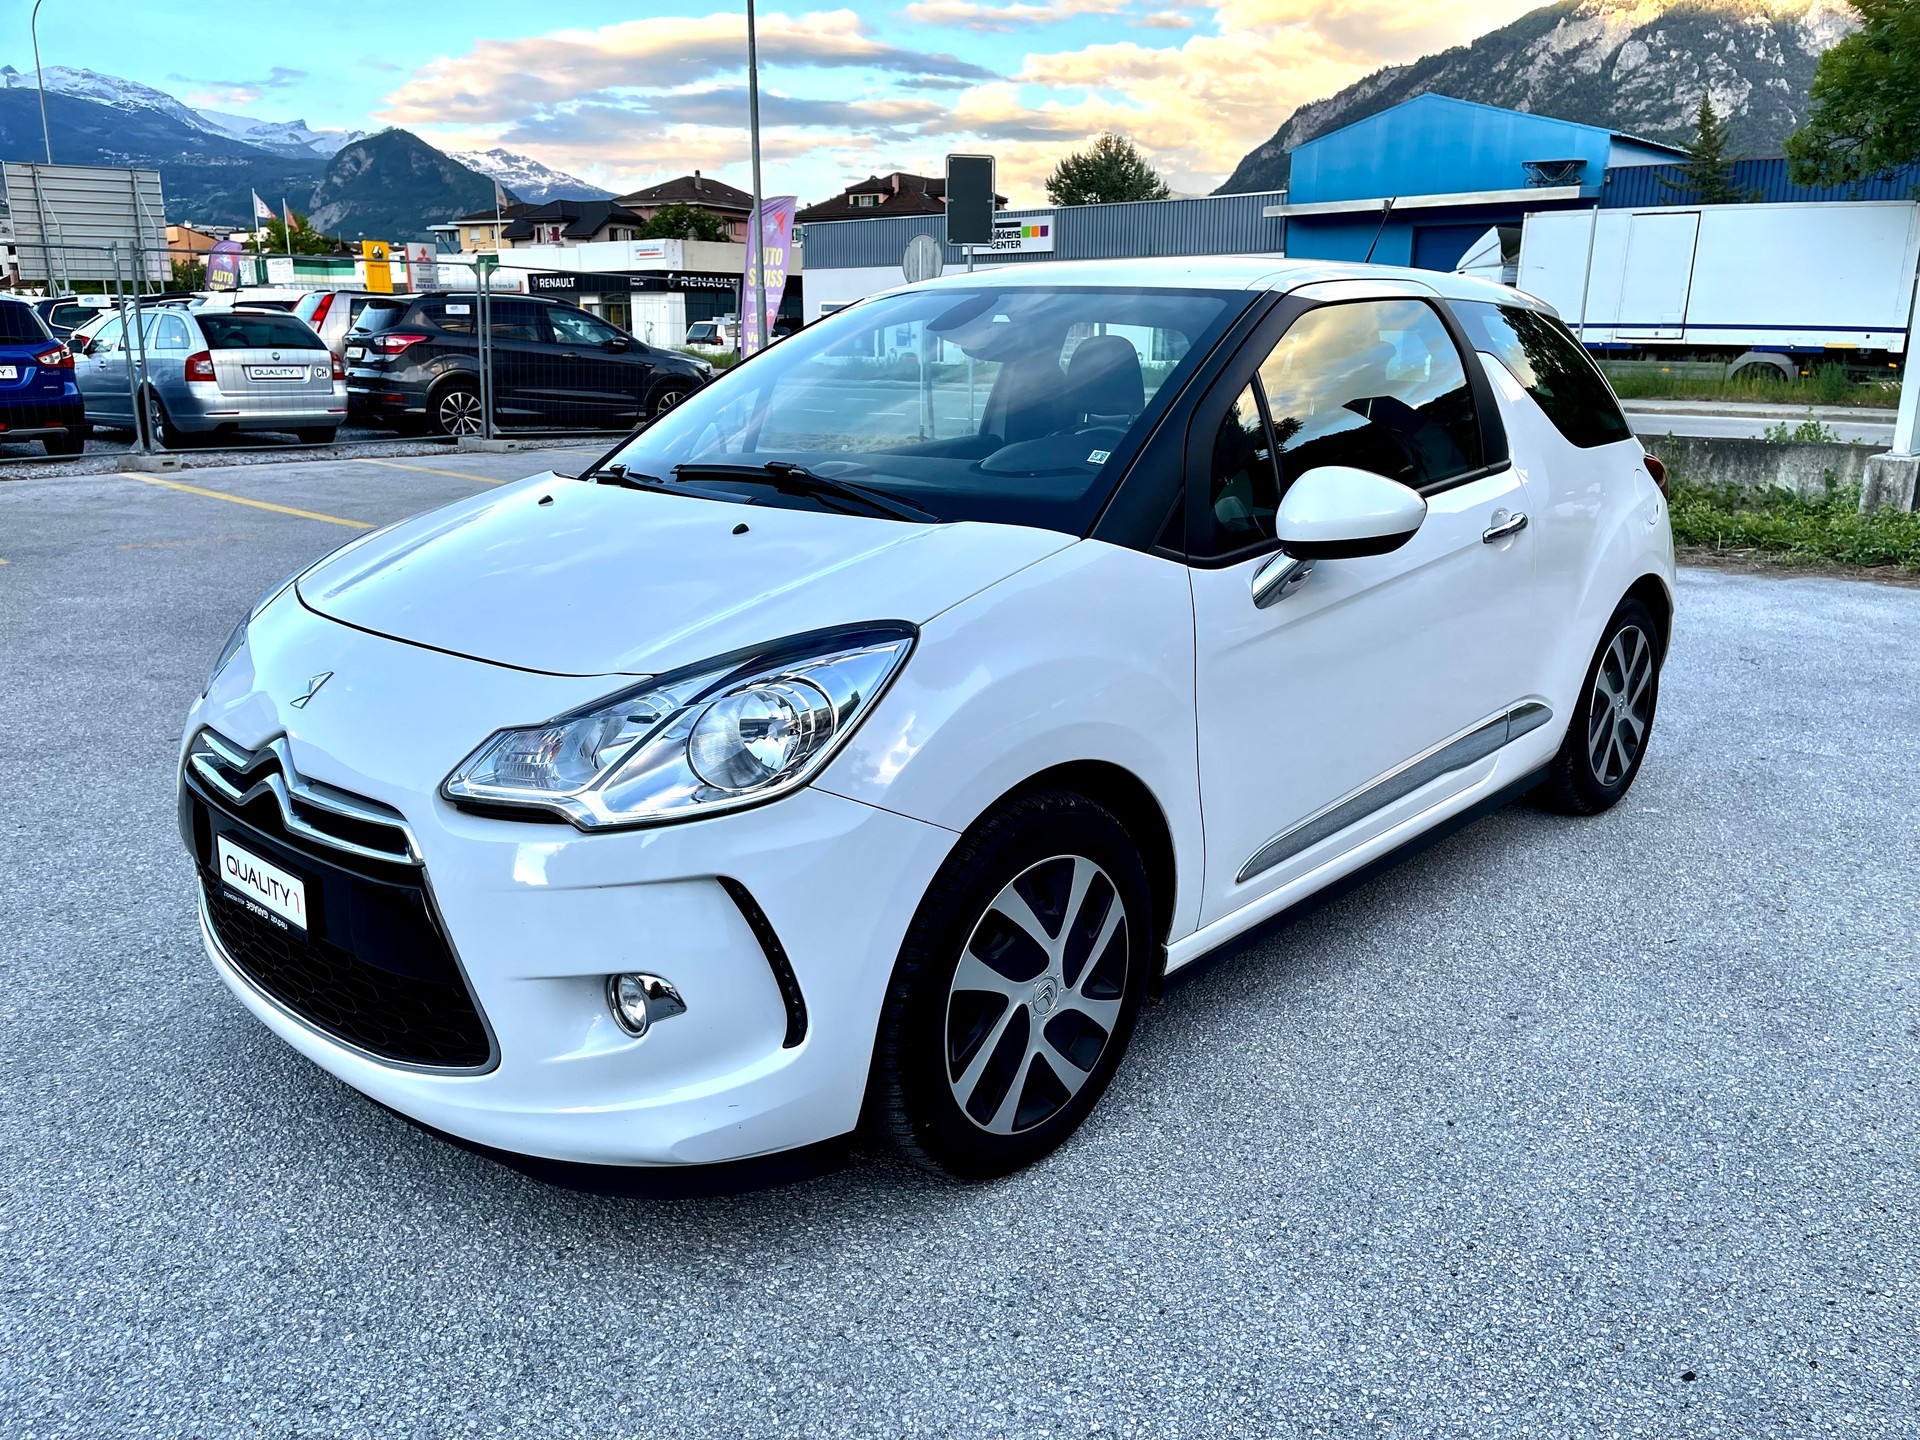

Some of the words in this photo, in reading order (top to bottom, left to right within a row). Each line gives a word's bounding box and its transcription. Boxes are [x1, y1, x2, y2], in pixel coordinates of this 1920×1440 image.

[994, 229, 1021, 239] ikkens
[991, 240, 1021, 250] CENTER
[212, 269, 234, 285] AUTO
[539, 277, 575, 288] RENAULT
[680, 276, 738, 288] RENAULT
[316, 368, 328, 378] CH
[226, 854, 290, 907] QUALITY
